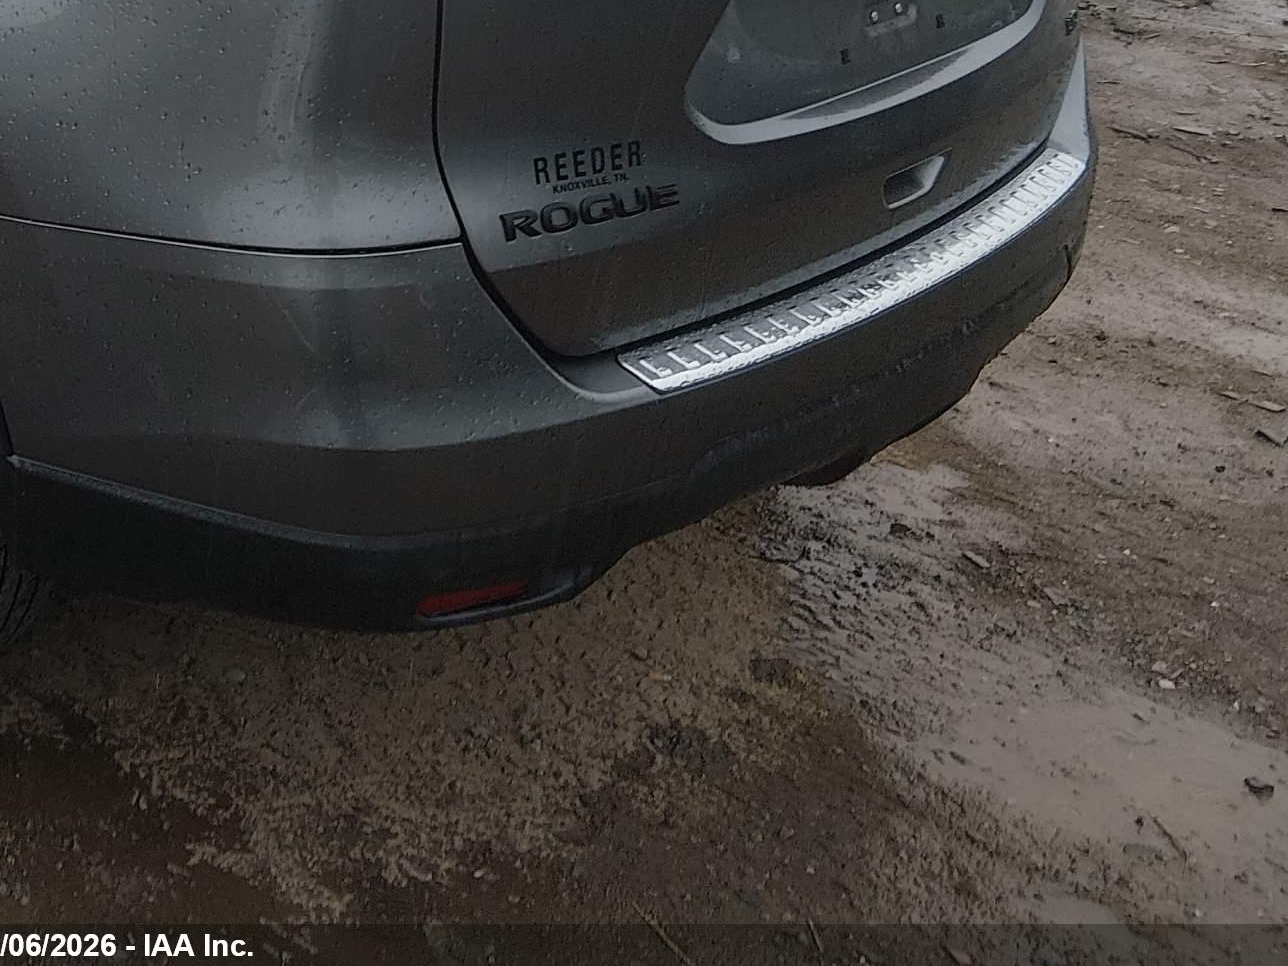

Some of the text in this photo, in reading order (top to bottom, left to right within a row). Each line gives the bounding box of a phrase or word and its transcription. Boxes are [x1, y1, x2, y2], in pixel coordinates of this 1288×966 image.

[533, 140, 642, 185] REEDER
[552, 176, 612, 195] KNOXVILLE,
[499, 184, 680, 243] ROGUE
